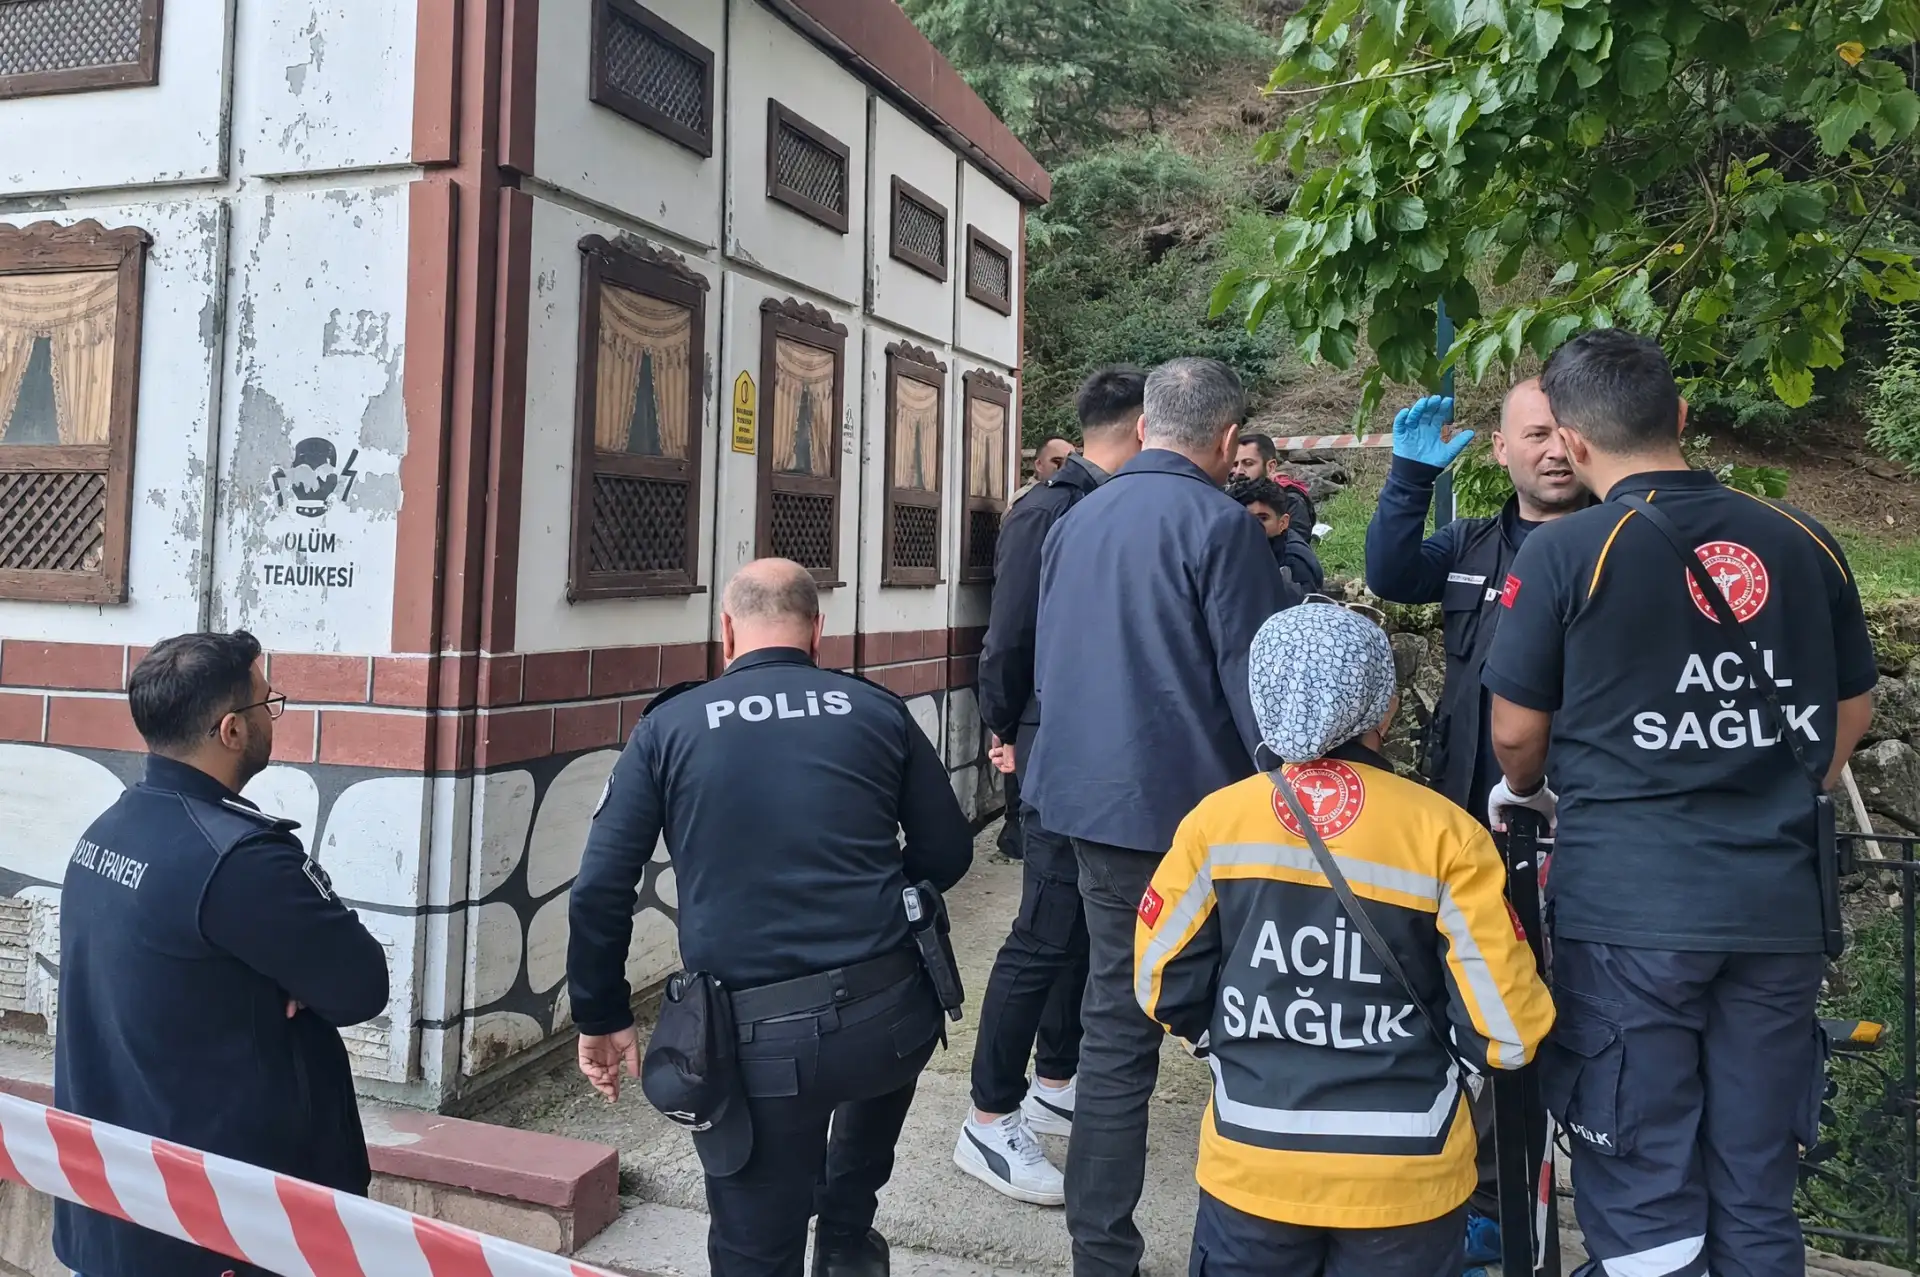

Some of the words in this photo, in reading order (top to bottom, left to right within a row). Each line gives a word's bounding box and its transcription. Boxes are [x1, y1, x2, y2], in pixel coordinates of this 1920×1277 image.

[1632, 699, 1821, 751] SAĞLK
[1250, 916, 1381, 984] ACİL
[1222, 985, 1415, 1049] SAĞLIK
